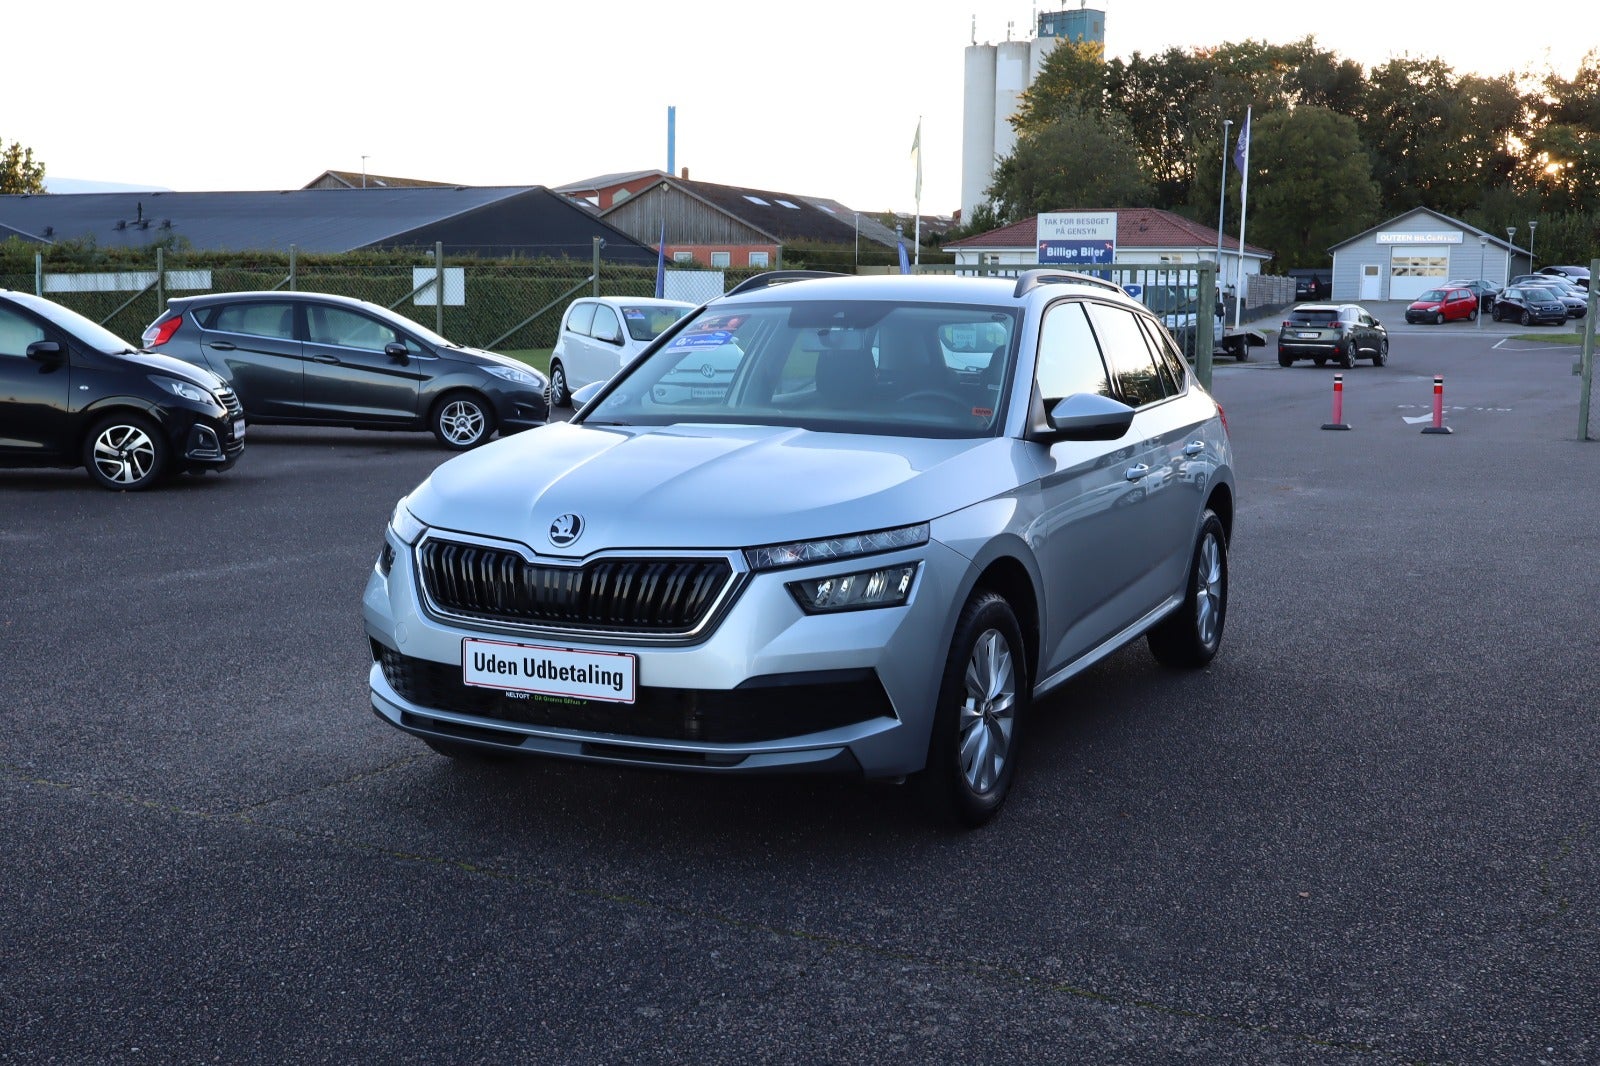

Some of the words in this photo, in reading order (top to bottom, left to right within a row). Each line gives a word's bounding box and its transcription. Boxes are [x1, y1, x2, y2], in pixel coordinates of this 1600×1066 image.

[1380, 234, 1413, 242] OUTZEN
[1046, 247, 1078, 259] Billige
[1080, 247, 1105, 257] Biler
[474, 652, 518, 676] Uden
[523, 657, 623, 692] Udbetaling
[505, 690, 530, 700] NELTOFT
